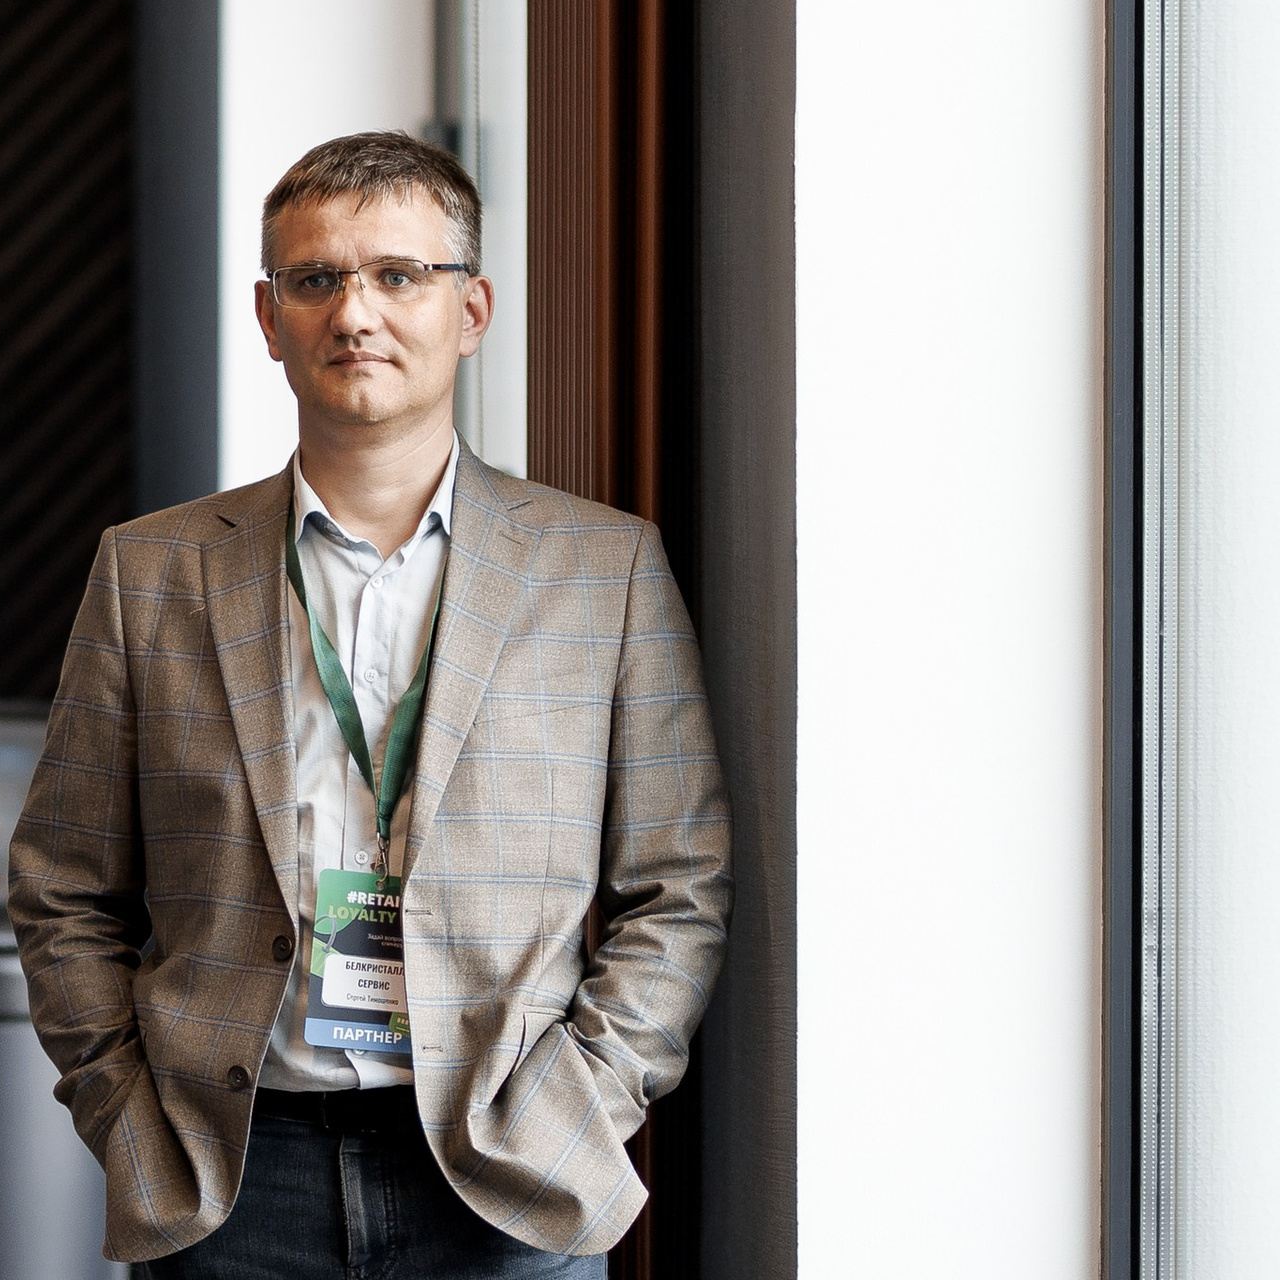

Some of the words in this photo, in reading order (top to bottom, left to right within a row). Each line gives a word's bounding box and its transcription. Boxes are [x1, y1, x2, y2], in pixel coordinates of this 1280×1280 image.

[346, 890, 401, 908] #RETAI
[328, 905, 397, 924] LOYALTY
[357, 978, 391, 991] СЕРВИС
[332, 1026, 403, 1044] ПАРТНЕР
